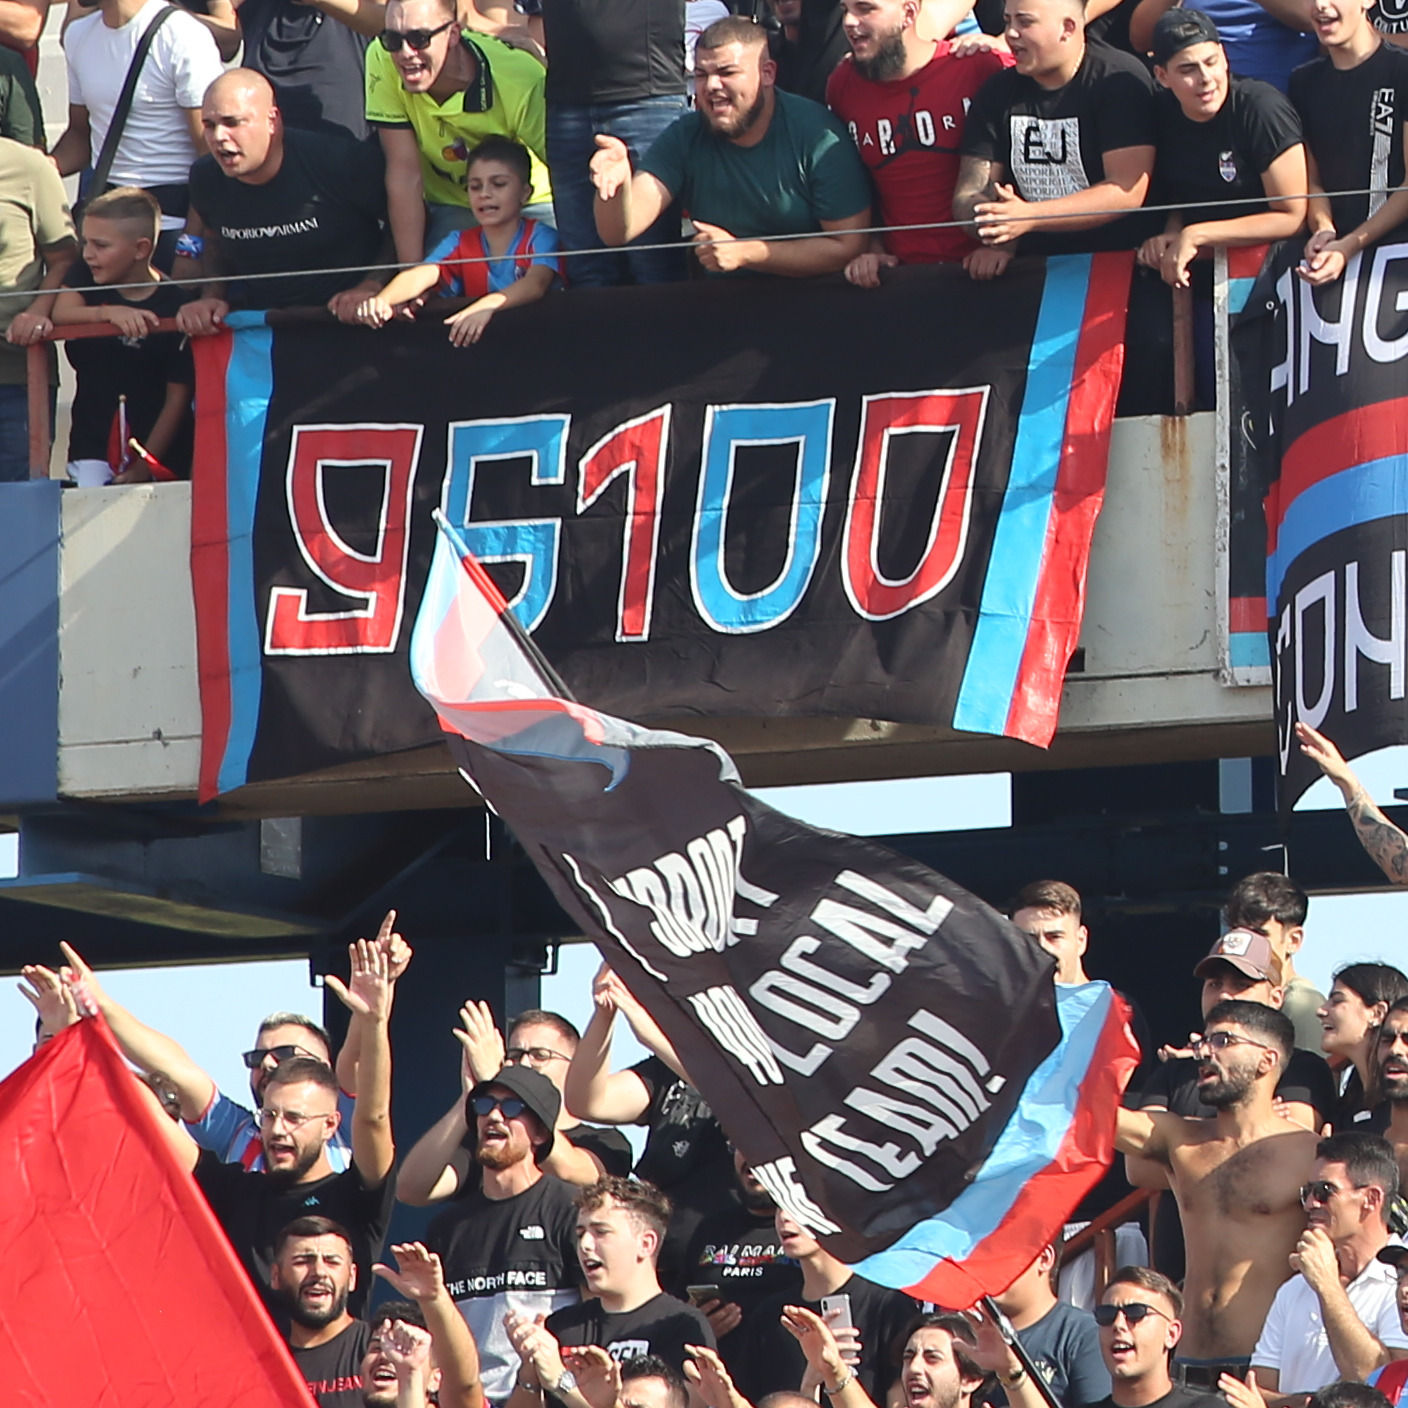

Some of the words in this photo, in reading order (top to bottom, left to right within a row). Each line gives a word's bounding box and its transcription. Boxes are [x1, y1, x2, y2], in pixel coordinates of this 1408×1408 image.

[276, 218, 319, 236] ARMANI
[263, 383, 991, 656] 95100
[749, 868, 956, 1078] LOCAL
[467, 1272, 506, 1294] NORTH
[507, 1271, 547, 1286] FACE
[723, 1267, 764, 1277] PARIS
